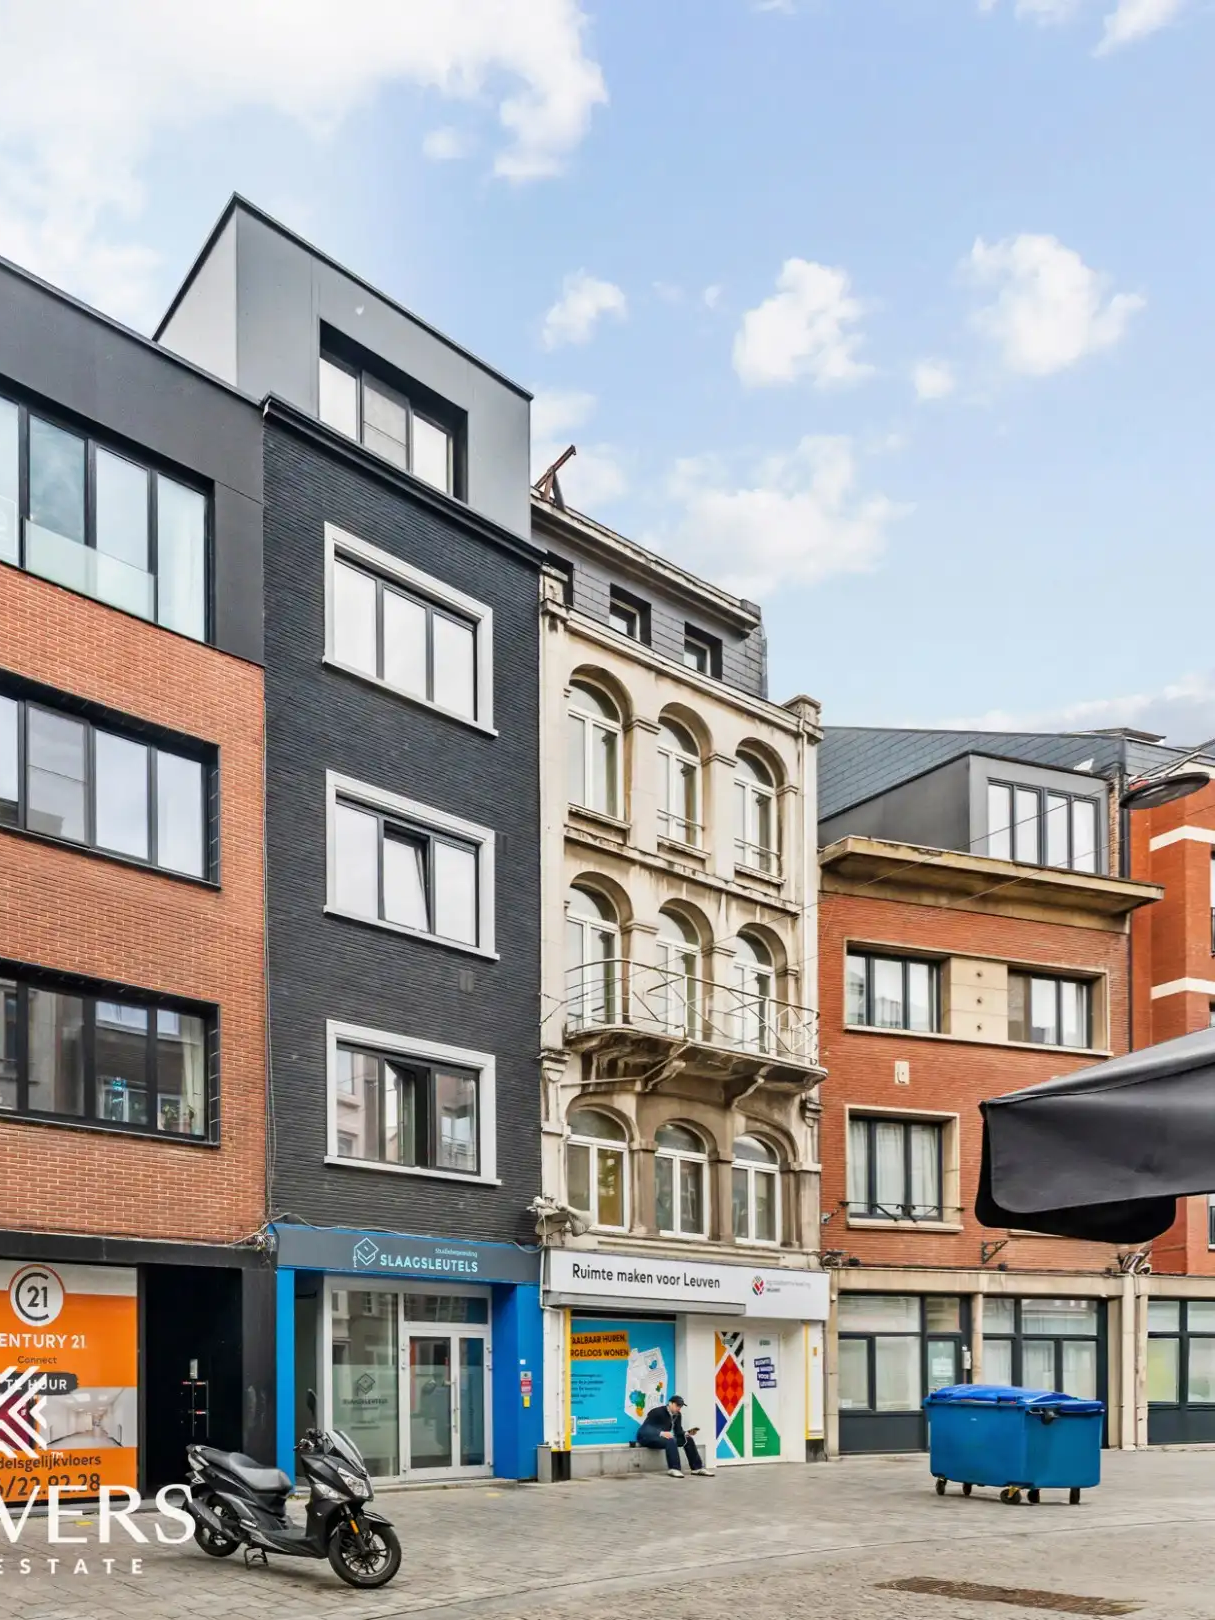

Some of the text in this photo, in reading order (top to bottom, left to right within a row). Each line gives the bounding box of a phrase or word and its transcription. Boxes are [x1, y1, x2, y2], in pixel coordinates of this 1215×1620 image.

[379, 1254, 478, 1273] SLAAGSLEUTELS
[572, 1262, 721, 1289] Ruimte maken voor Leuven
[71, 1334, 86, 1349] 21
[17, 1355, 58, 1365] Connect
